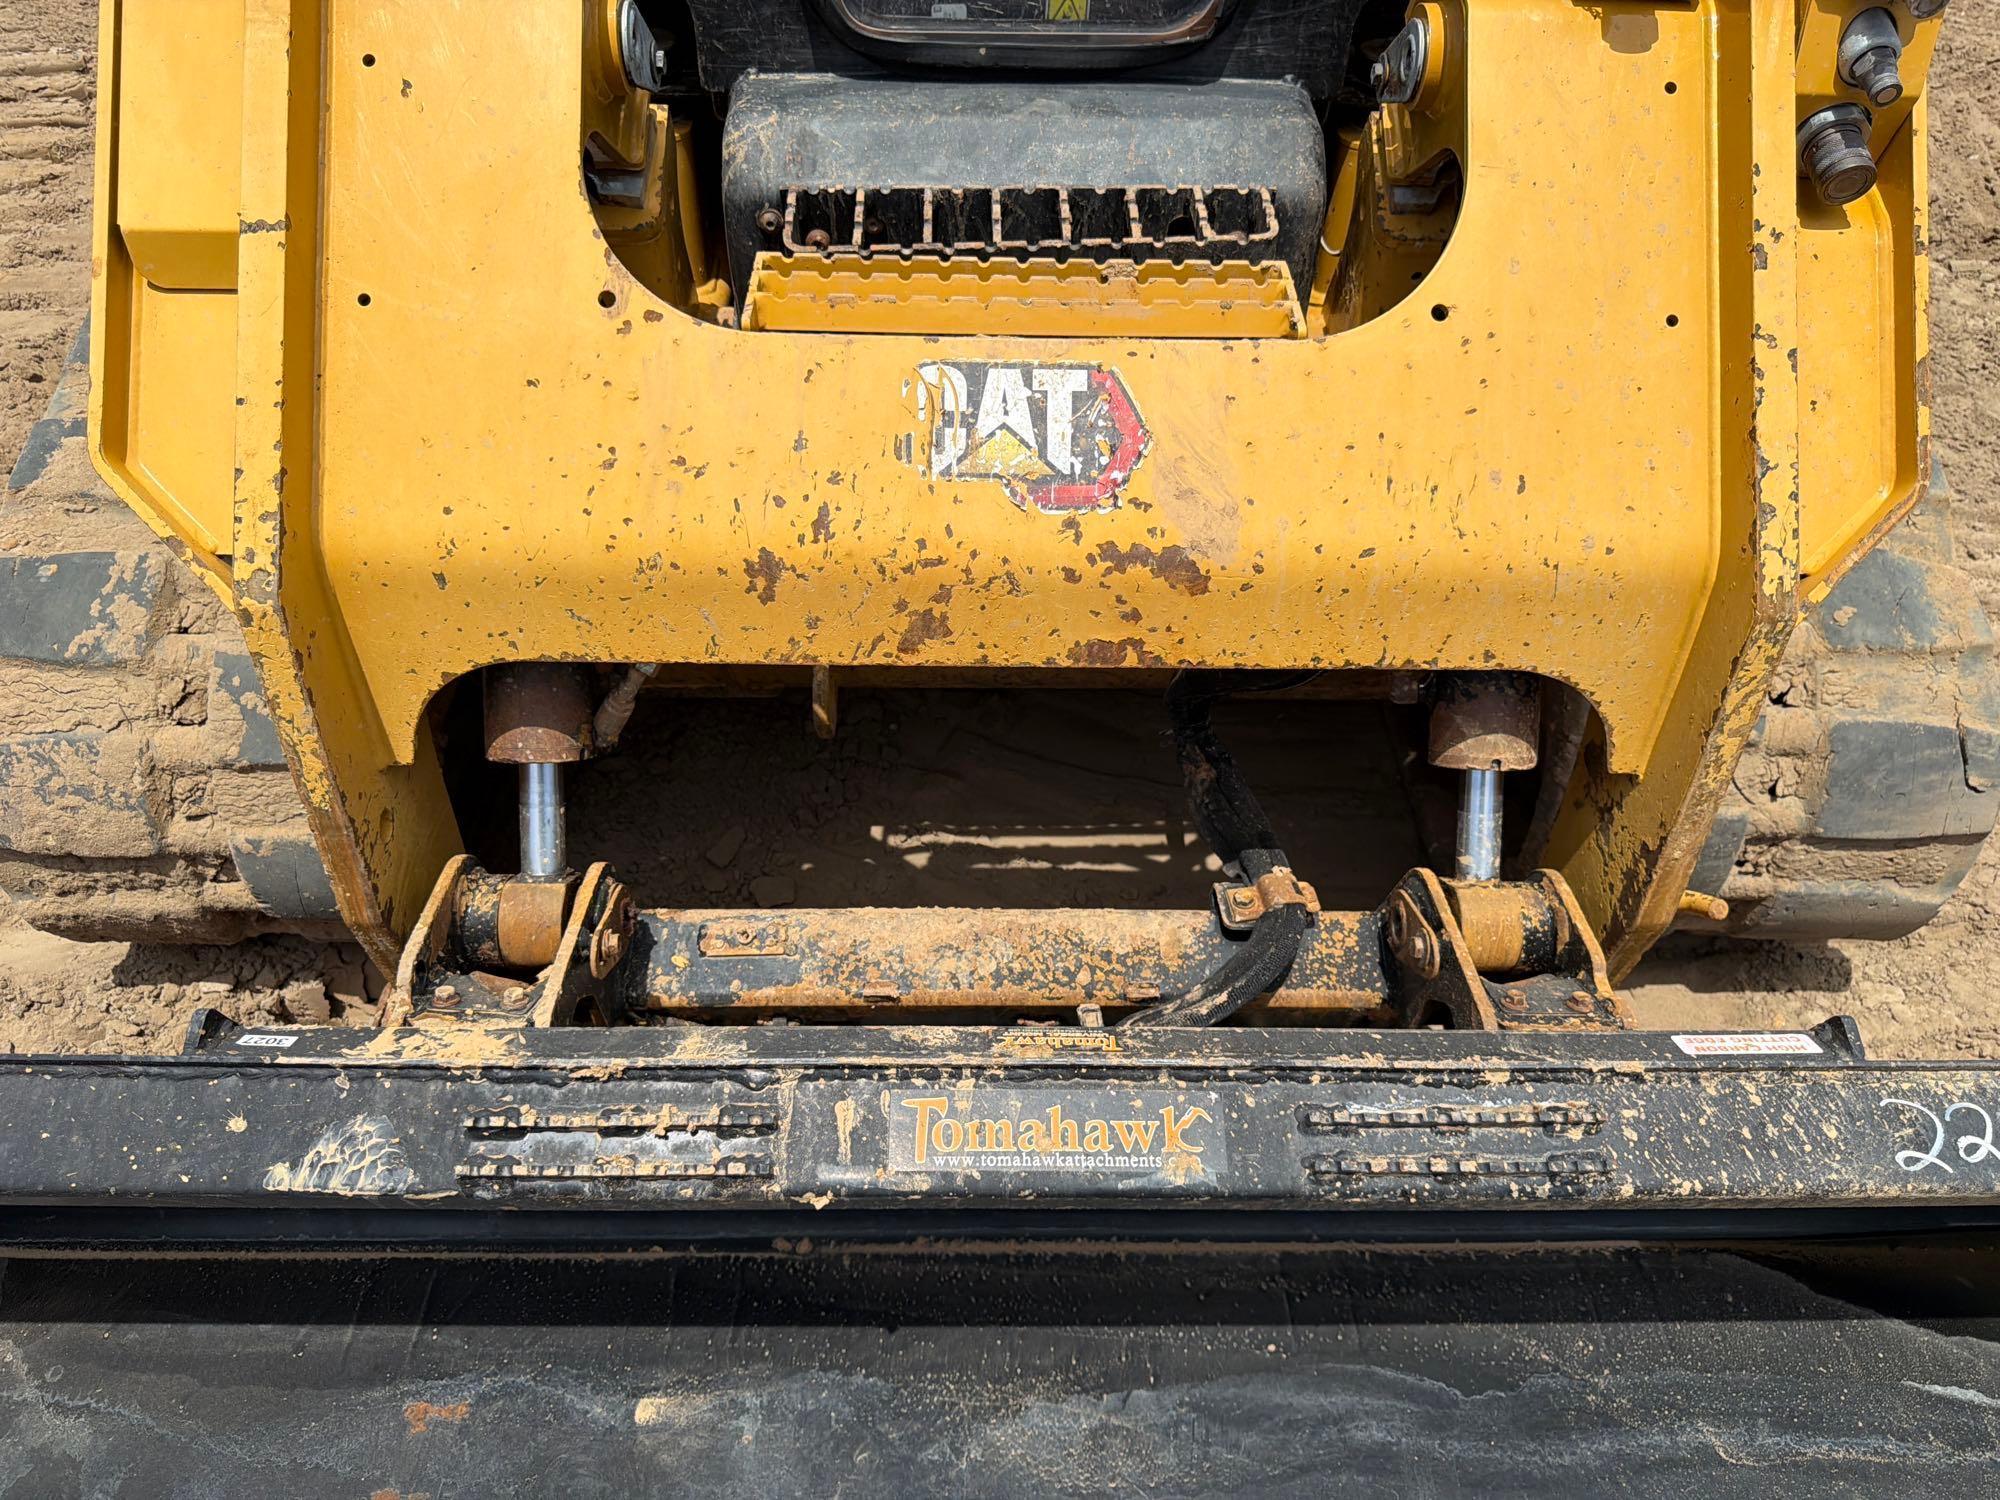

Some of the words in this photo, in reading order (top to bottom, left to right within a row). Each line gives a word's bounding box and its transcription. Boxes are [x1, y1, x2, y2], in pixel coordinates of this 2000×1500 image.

[242, 1036, 289, 1045] 3027
[1729, 1036, 1801, 1044] CUTTING
[1695, 1044, 1761, 1053] CARBON
[1879, 1098, 2000, 1174] 22
[932, 1151, 1203, 1169] www.tomahawkattachments.c
